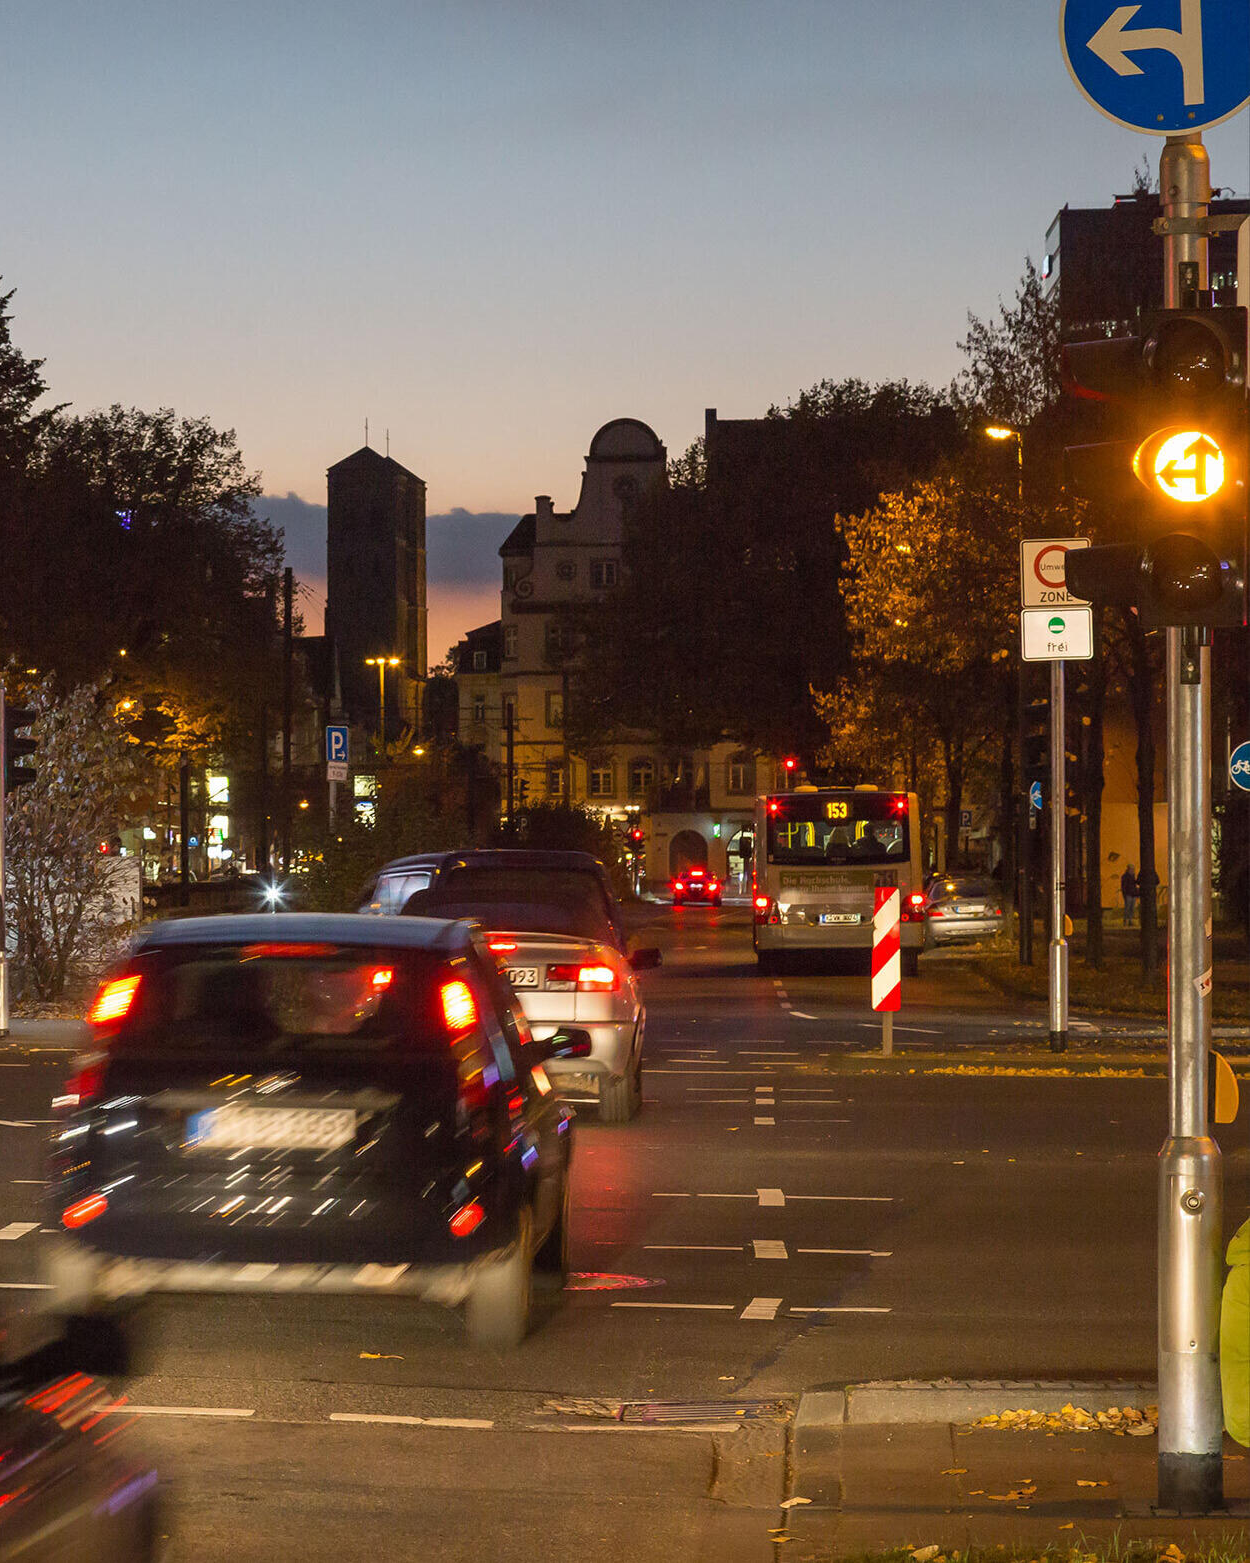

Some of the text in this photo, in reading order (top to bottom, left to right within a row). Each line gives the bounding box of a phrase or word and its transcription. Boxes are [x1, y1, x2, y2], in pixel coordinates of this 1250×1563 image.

[1040, 563, 1065, 572] Umwe
[1040, 591, 1074, 602] ZONE
[1047, 642, 1068, 652] frei
[332, 731, 343, 760] P
[826, 802, 848, 819] 153
